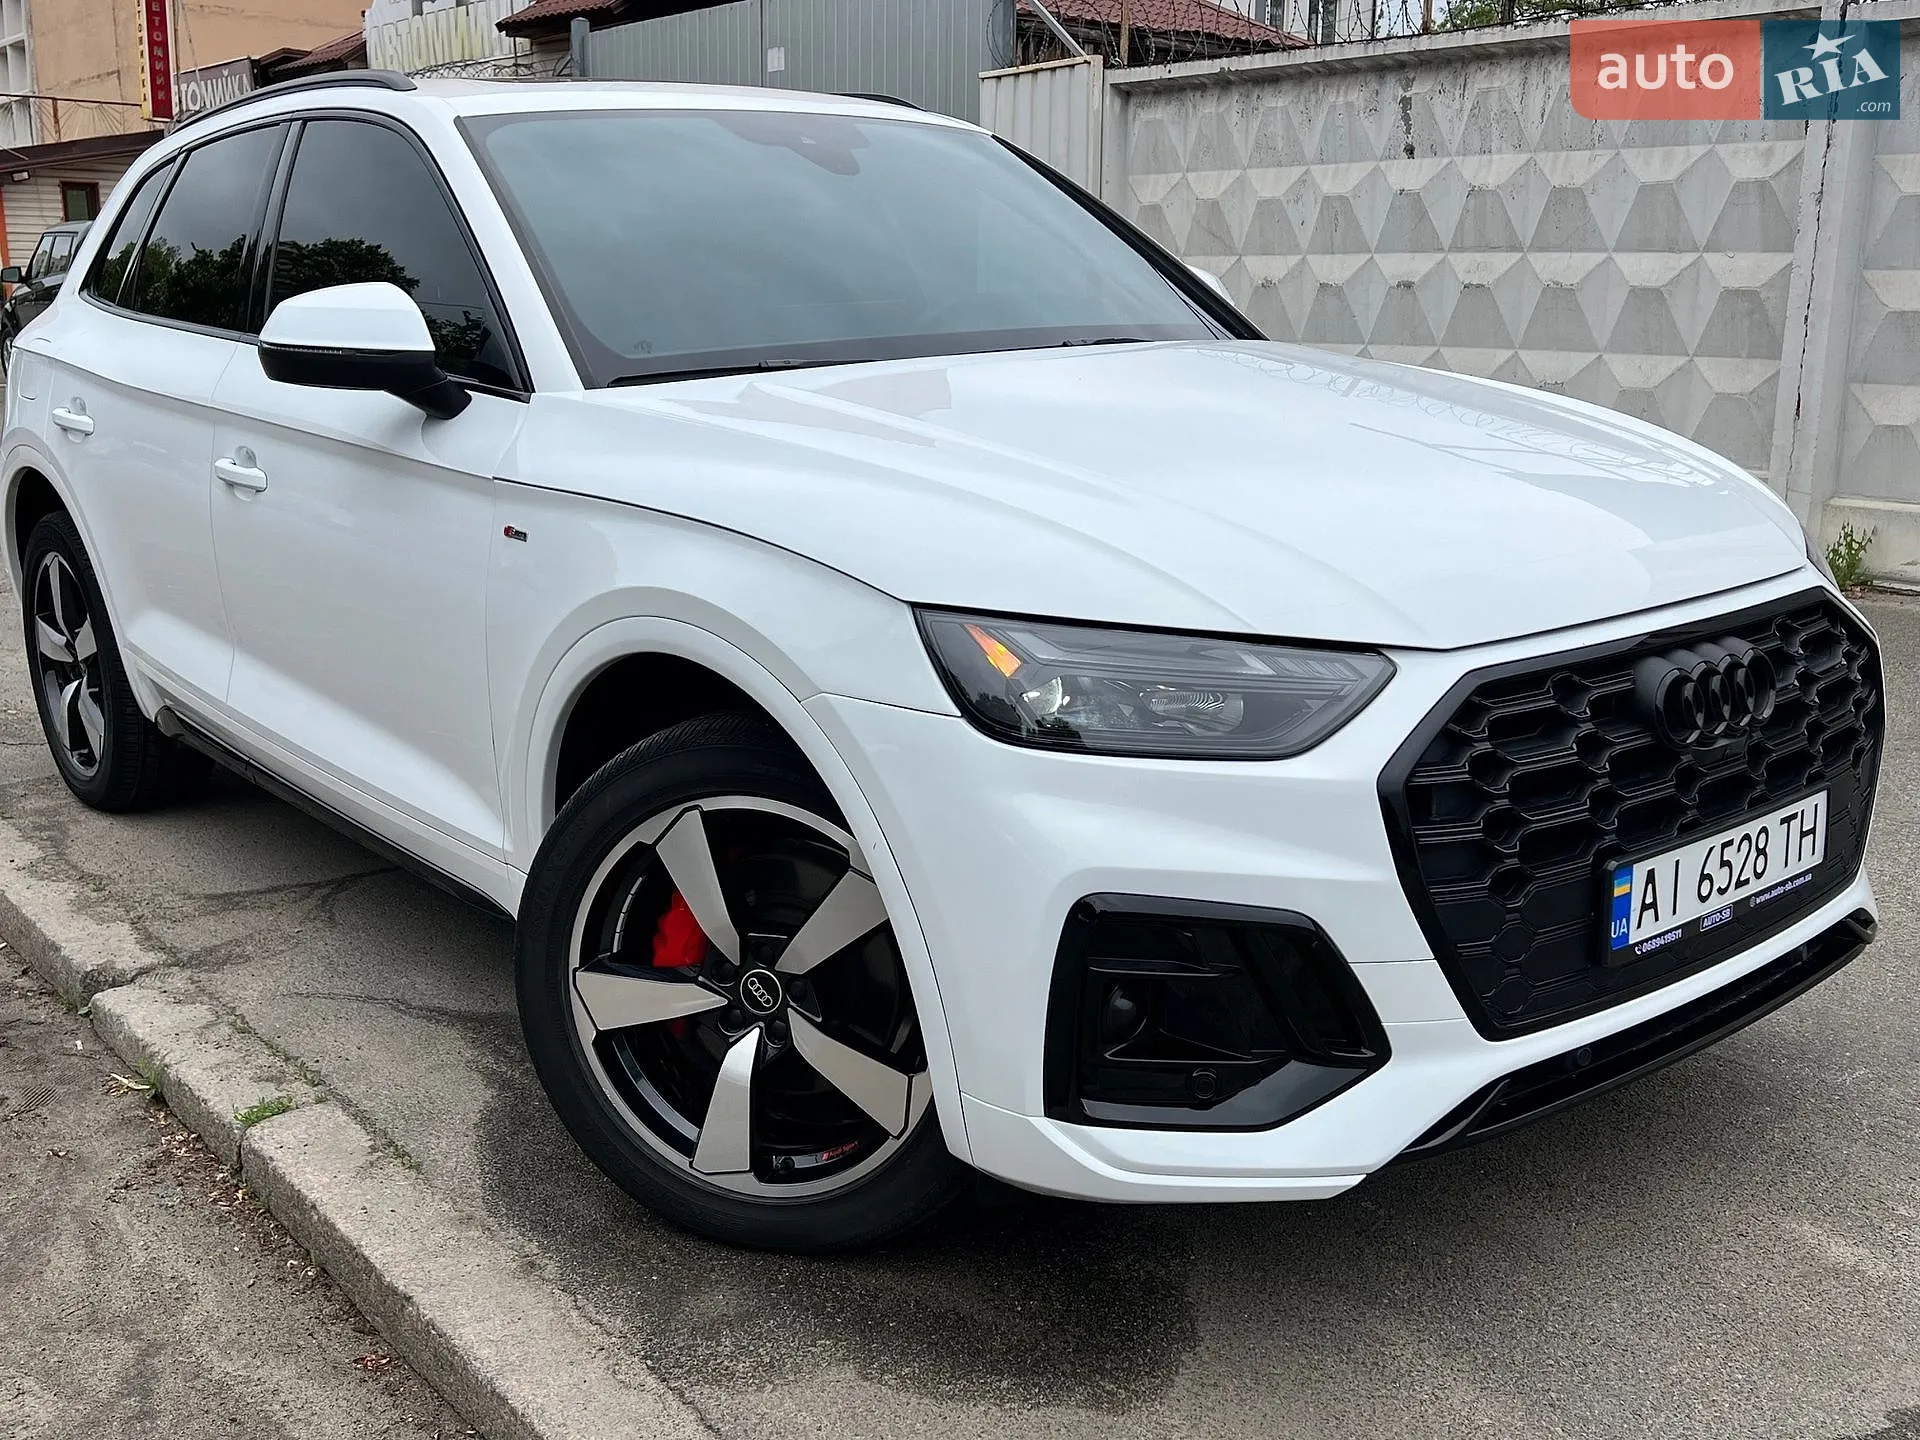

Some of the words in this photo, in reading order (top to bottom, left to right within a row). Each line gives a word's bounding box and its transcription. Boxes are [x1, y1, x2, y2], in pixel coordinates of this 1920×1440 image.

[1636, 859, 1680, 930] AI
[1697, 825, 1769, 903] 6528
[1780, 803, 1818, 868] TH
[1611, 918, 1628, 938] UA
[1703, 908, 1731, 928] AUTO-SB
